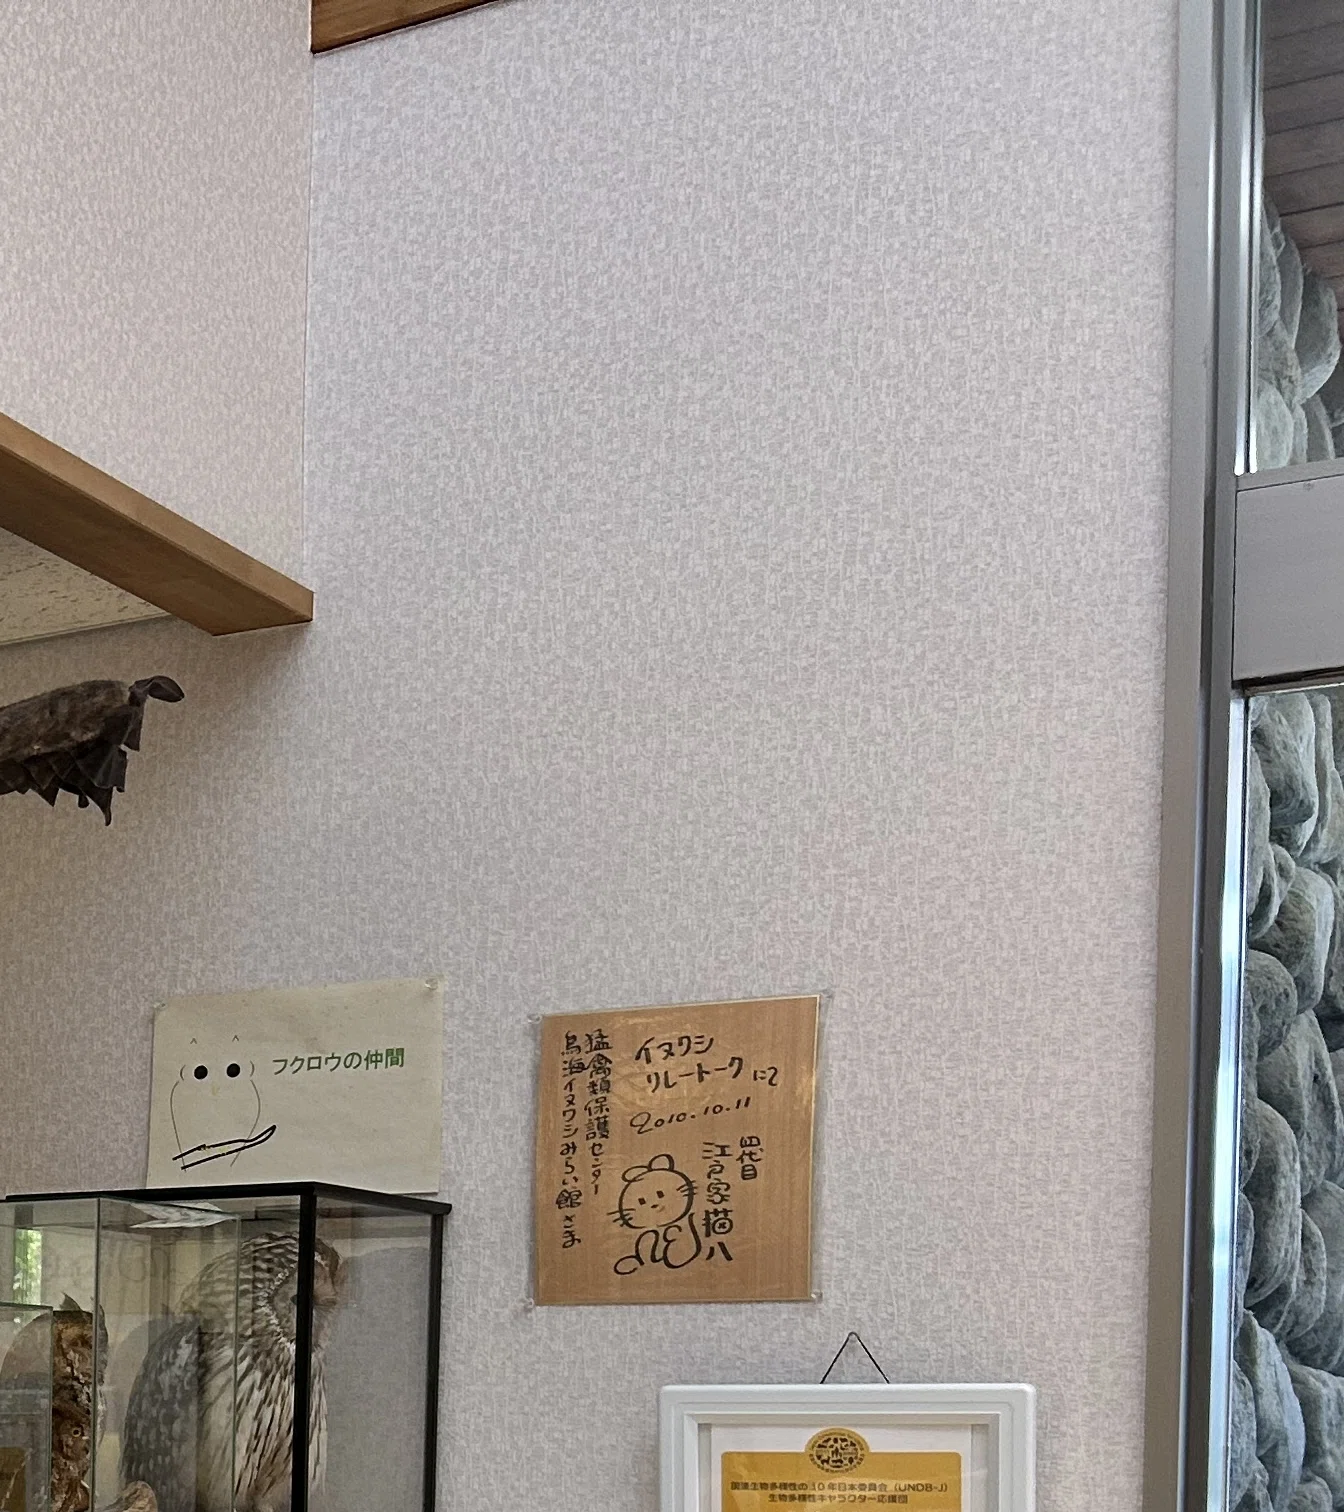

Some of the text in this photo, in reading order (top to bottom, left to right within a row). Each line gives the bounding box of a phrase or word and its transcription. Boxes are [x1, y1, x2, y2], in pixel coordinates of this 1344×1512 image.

[272, 1047, 406, 1076] フクロウの仲間
[634, 1033, 715, 1062] イヌワシ
[647, 1056, 744, 1093] リレートーク
[583, 1028, 614, 1195] 猛禽類保護センター
[630, 1096, 751, 1135] 2010.10.11
[555, 1031, 588, 1249] 鳥海イヌワシみらい館さま
[736, 1136, 764, 1181] 四代目
[702, 1140, 734, 1262] 江戸家猫八
